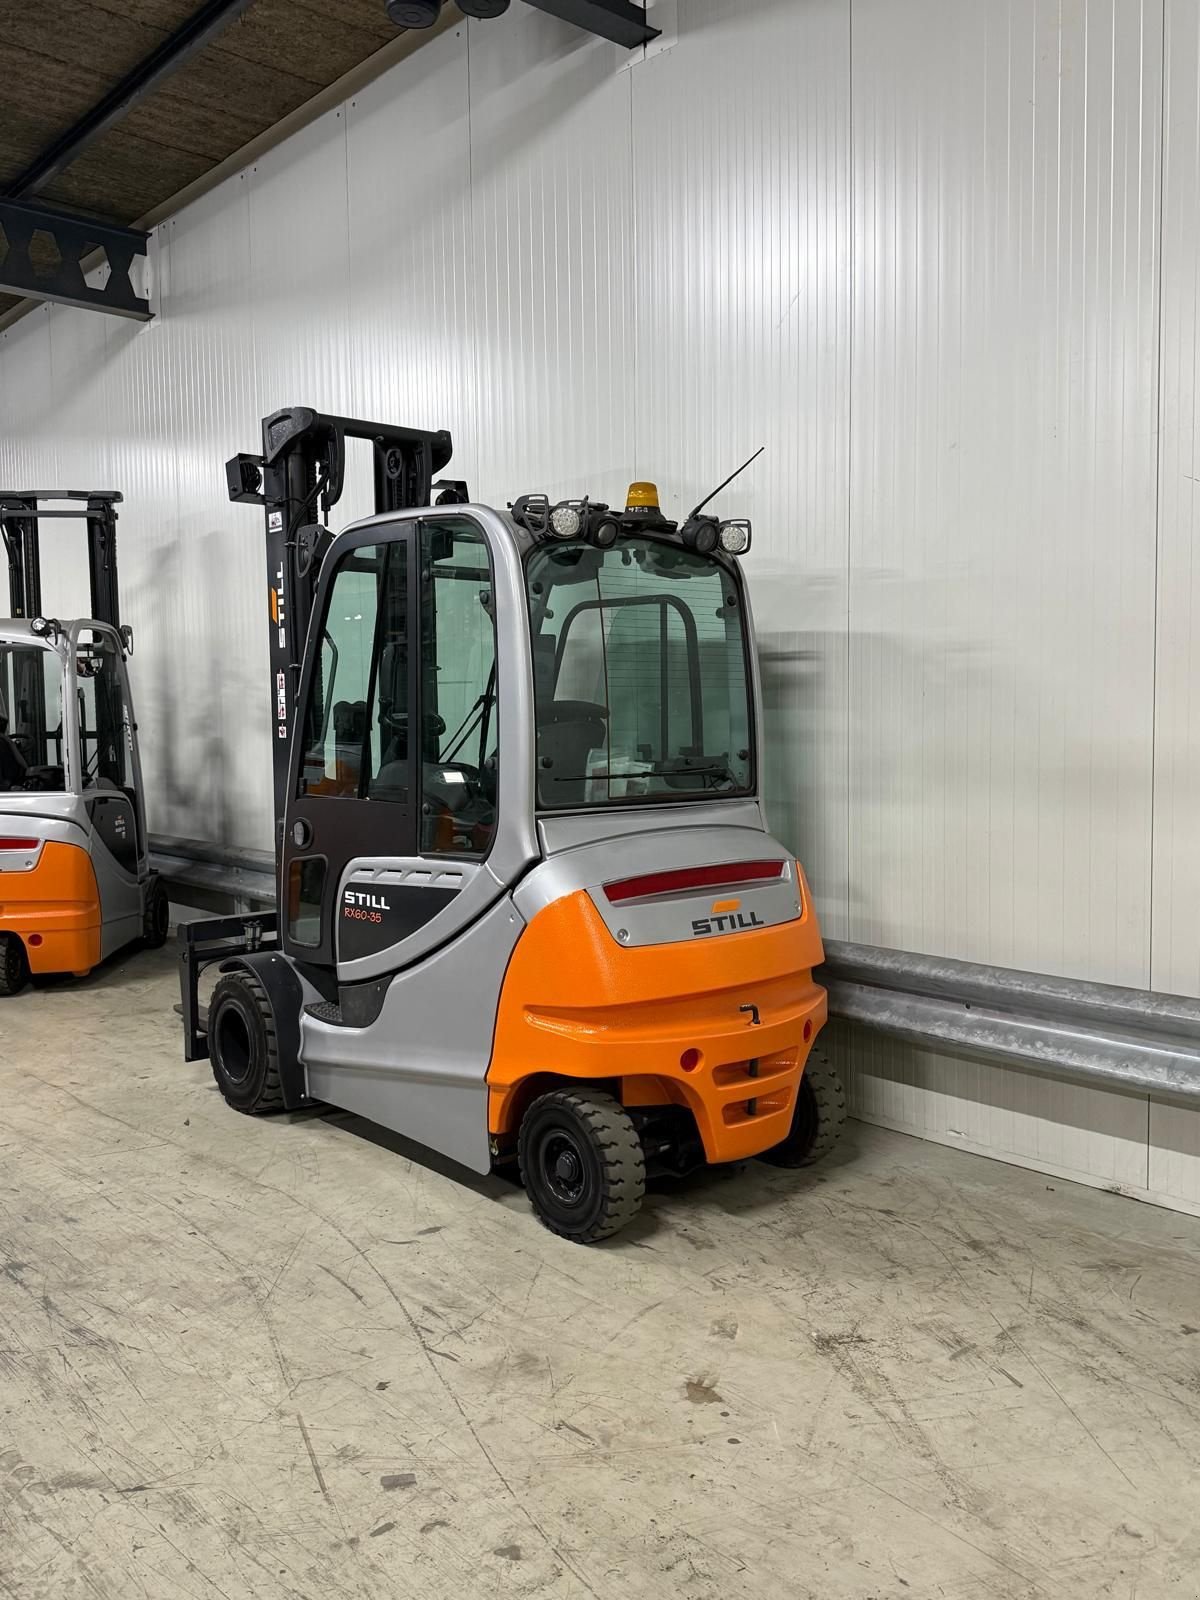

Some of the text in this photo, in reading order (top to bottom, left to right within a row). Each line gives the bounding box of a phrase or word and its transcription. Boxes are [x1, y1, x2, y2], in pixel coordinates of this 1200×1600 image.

[276, 561, 286, 648] STILL
[344, 890, 391, 910] STILL
[344, 907, 382, 923] RX60-35
[691, 911, 764, 936] STILL
